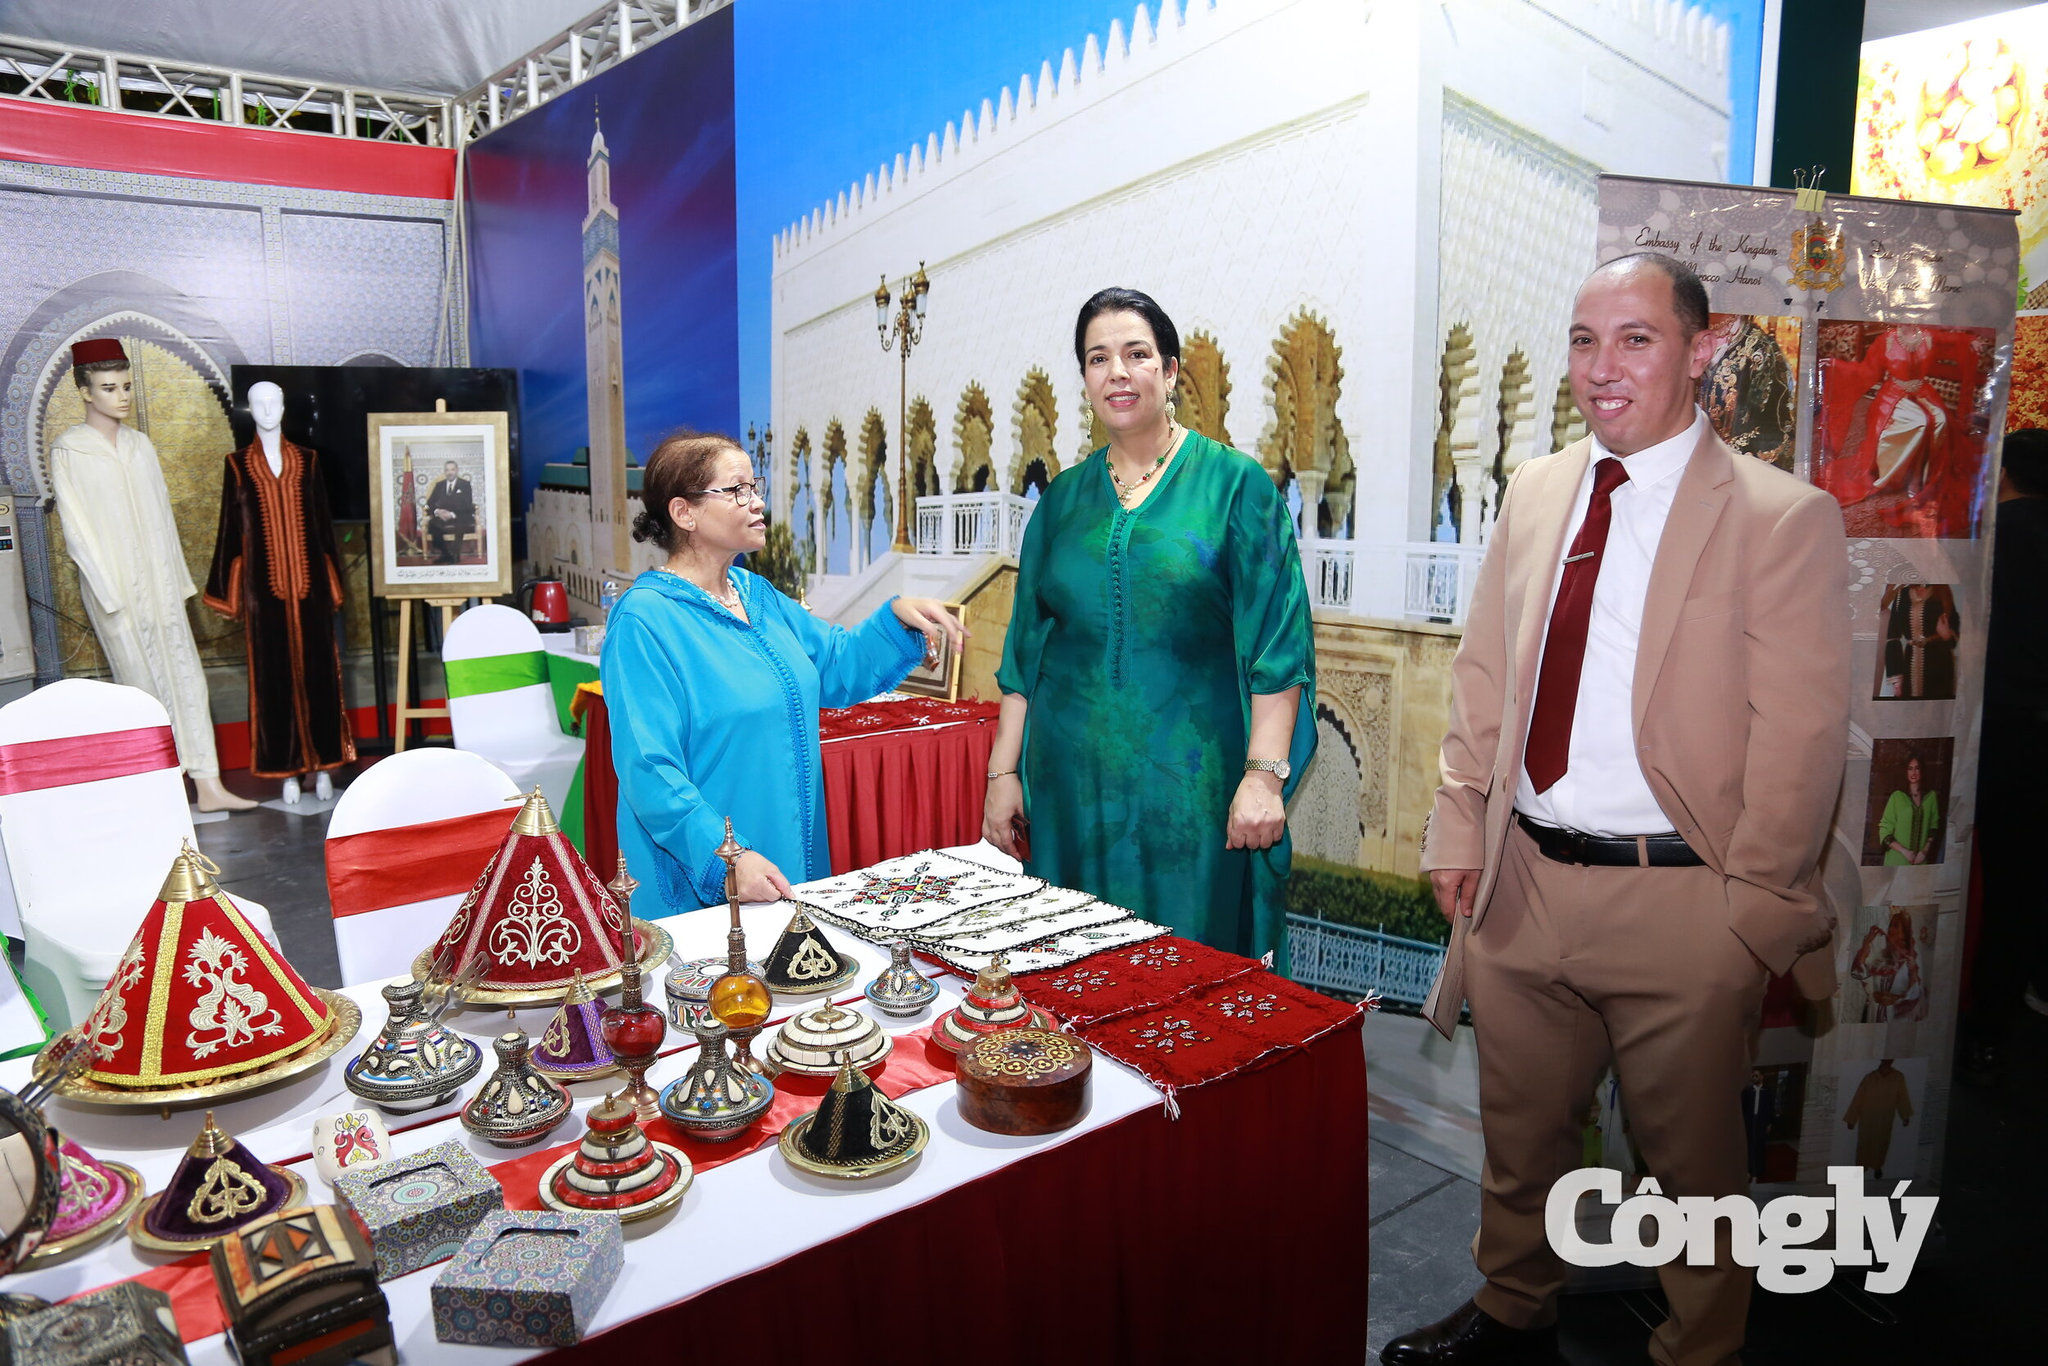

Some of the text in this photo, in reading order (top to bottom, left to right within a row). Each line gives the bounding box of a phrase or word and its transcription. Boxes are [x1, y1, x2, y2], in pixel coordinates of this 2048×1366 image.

[1634, 226, 1778, 259] Embassy of the Kingdom
[1726, 265, 1762, 286] Hanoi
